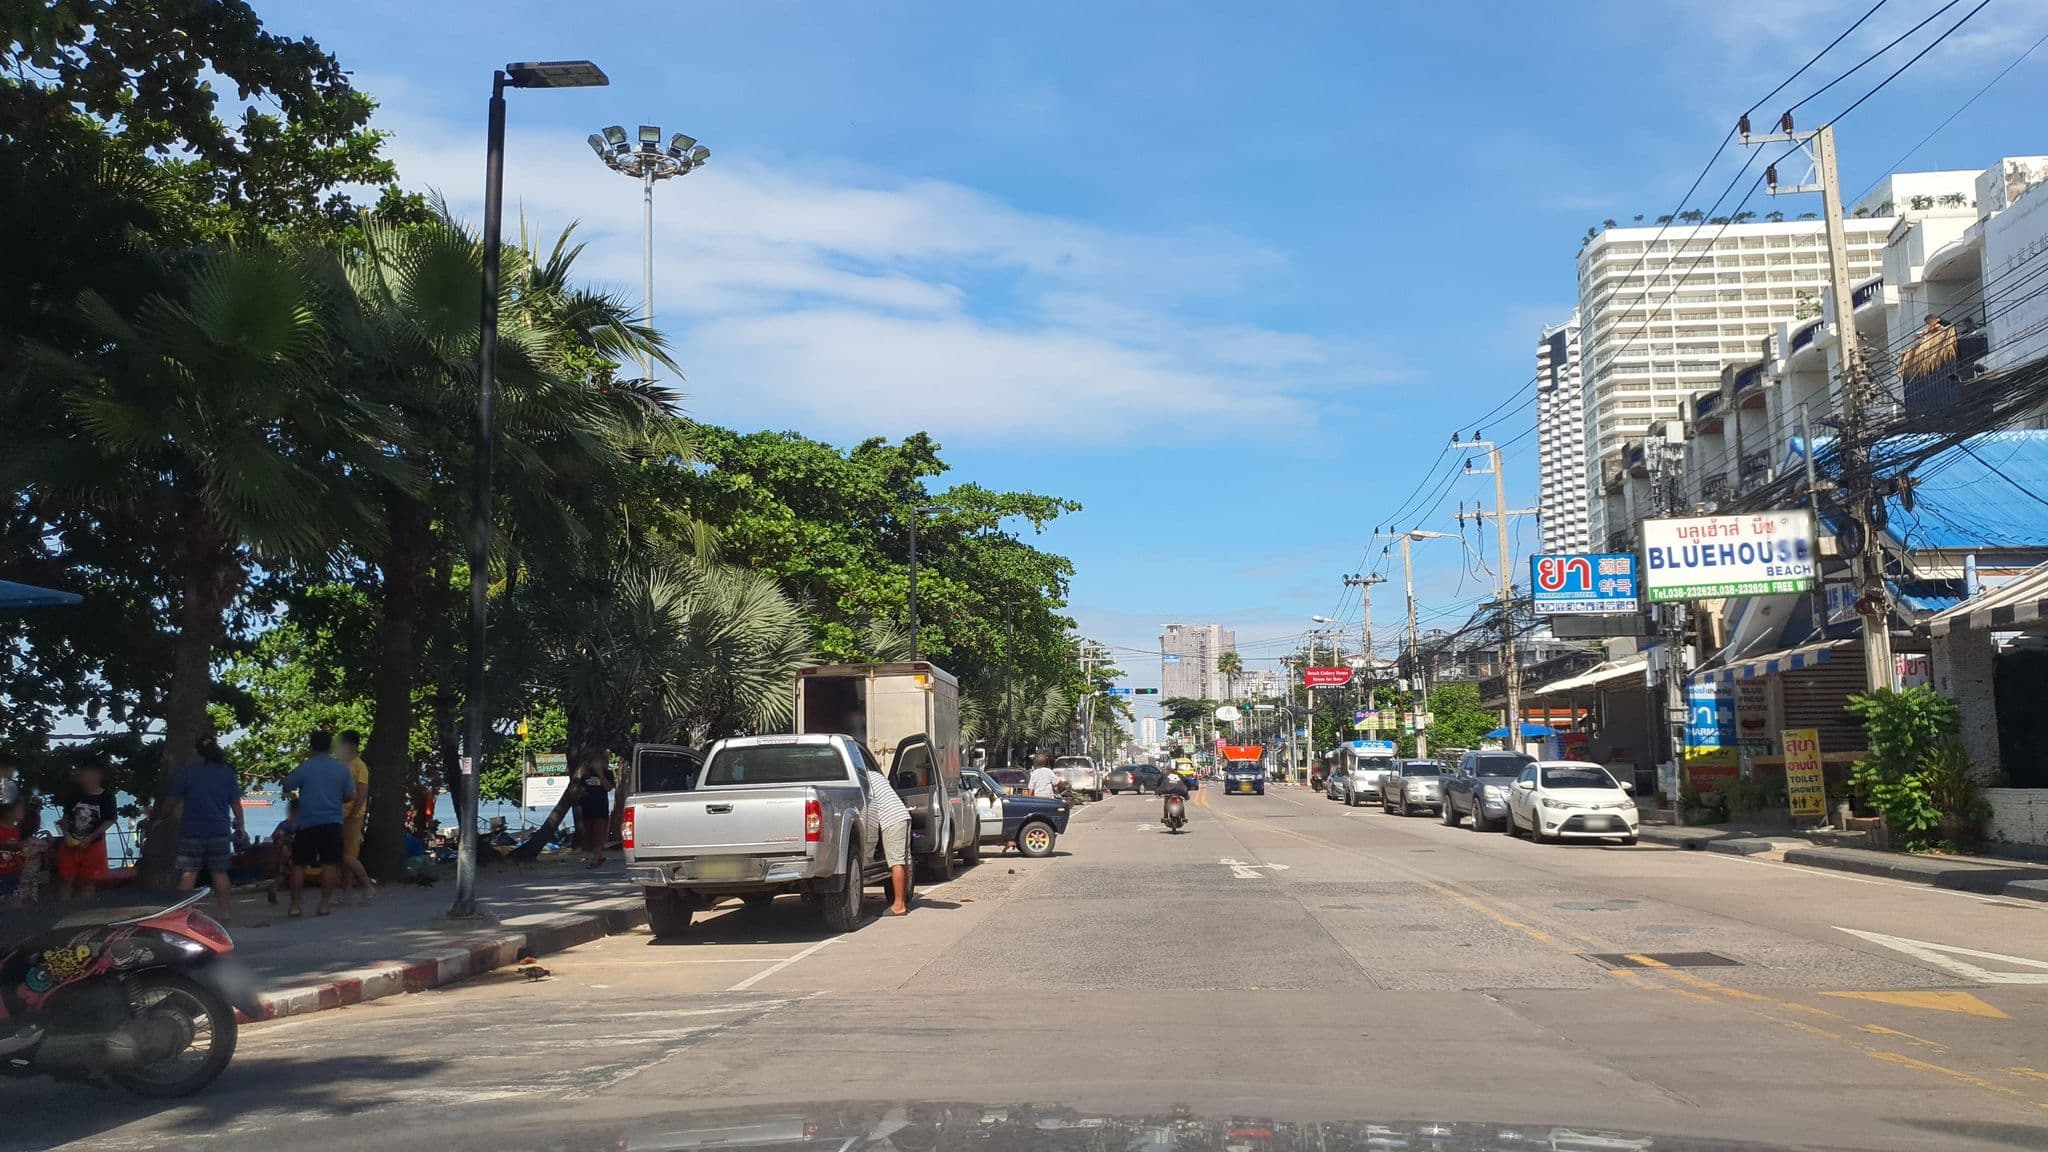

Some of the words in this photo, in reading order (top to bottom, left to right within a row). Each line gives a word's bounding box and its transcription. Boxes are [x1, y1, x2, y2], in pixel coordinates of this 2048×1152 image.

[1538, 557, 1592, 591] ยา
[1766, 564, 1812, 576] BEACH
[1772, 580, 1794, 593] FREE
[1790, 775, 1819, 784] TOILET
[1790, 785, 1823, 794] SHOWER
